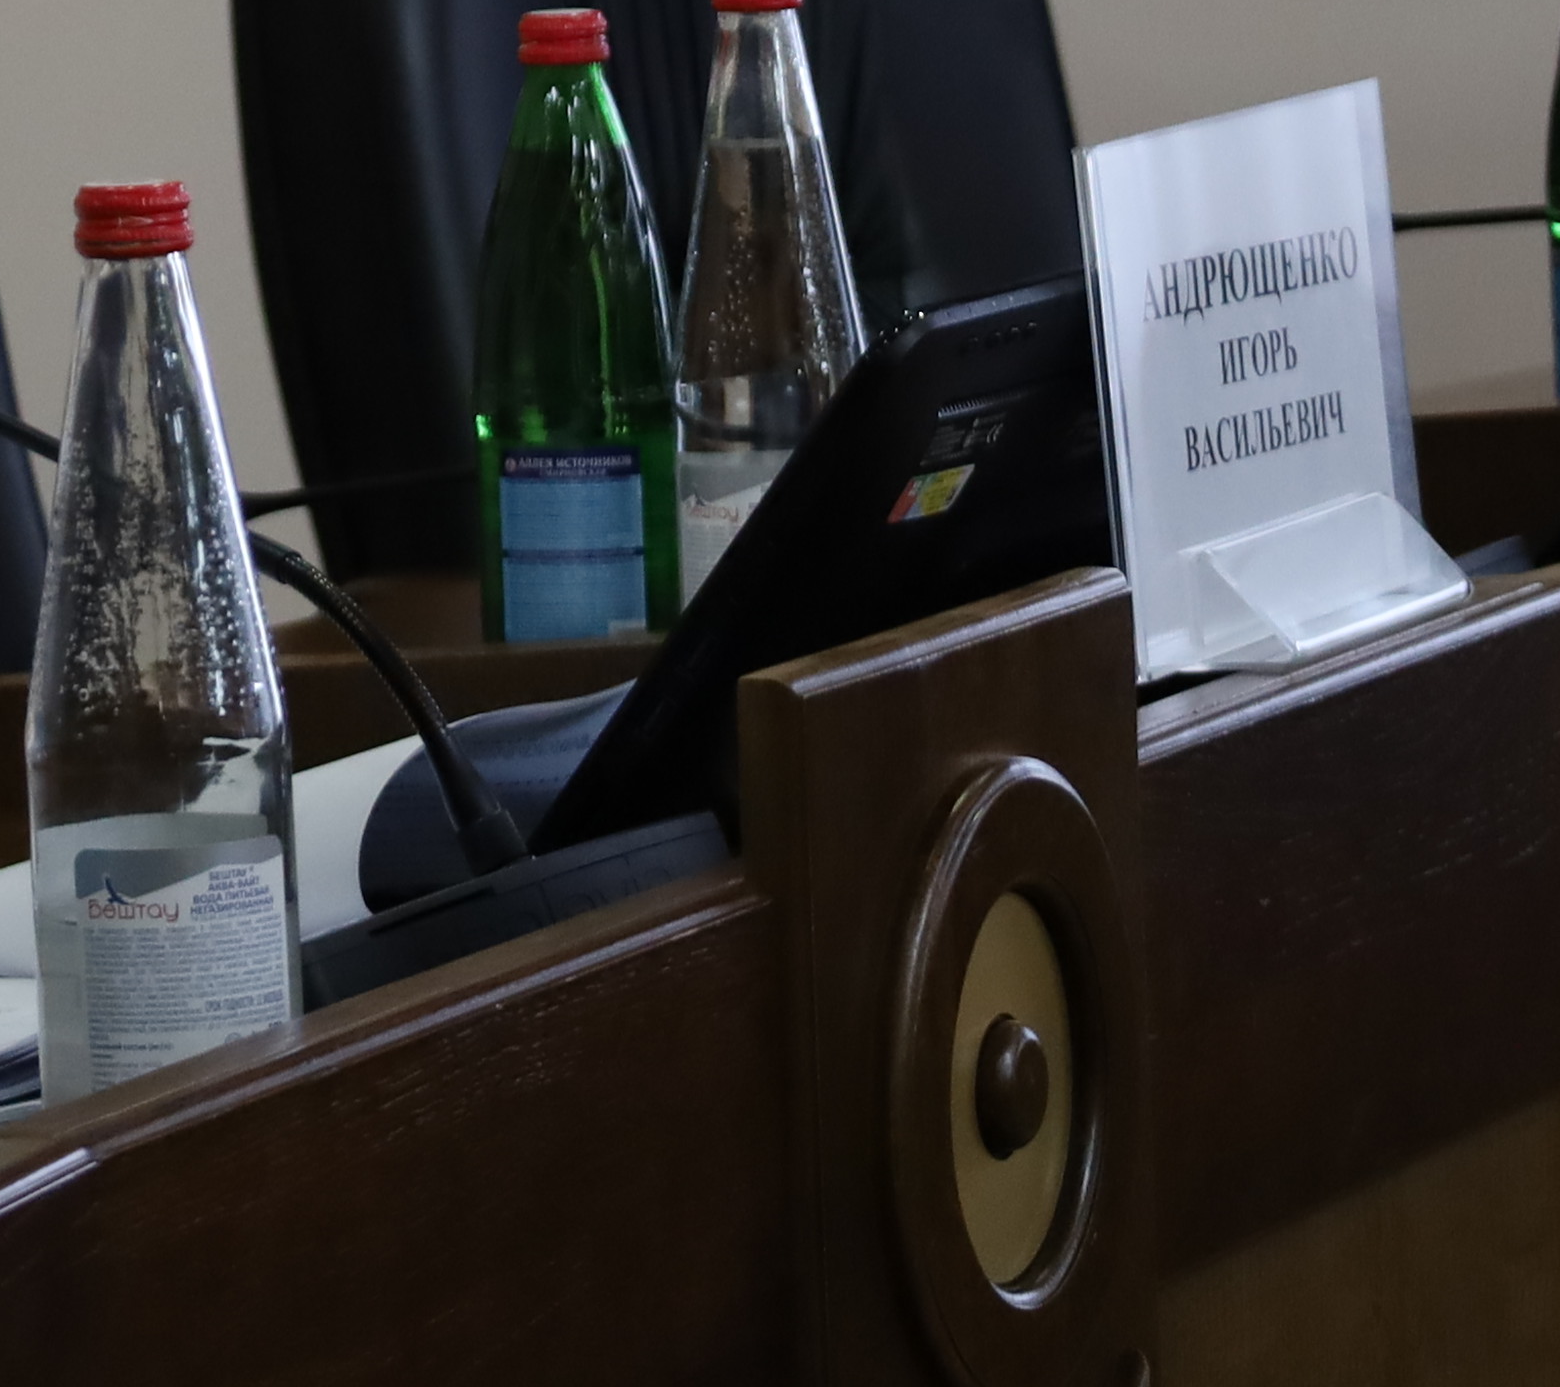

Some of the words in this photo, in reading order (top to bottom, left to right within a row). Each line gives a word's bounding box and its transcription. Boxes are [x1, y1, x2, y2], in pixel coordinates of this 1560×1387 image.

[1142, 225, 1359, 327] АНДРЮЩЕНКО
[1218, 325, 1298, 387] ИГОРЬ
[1185, 389, 1347, 473] ВАСИЛЬЕВИЧ
